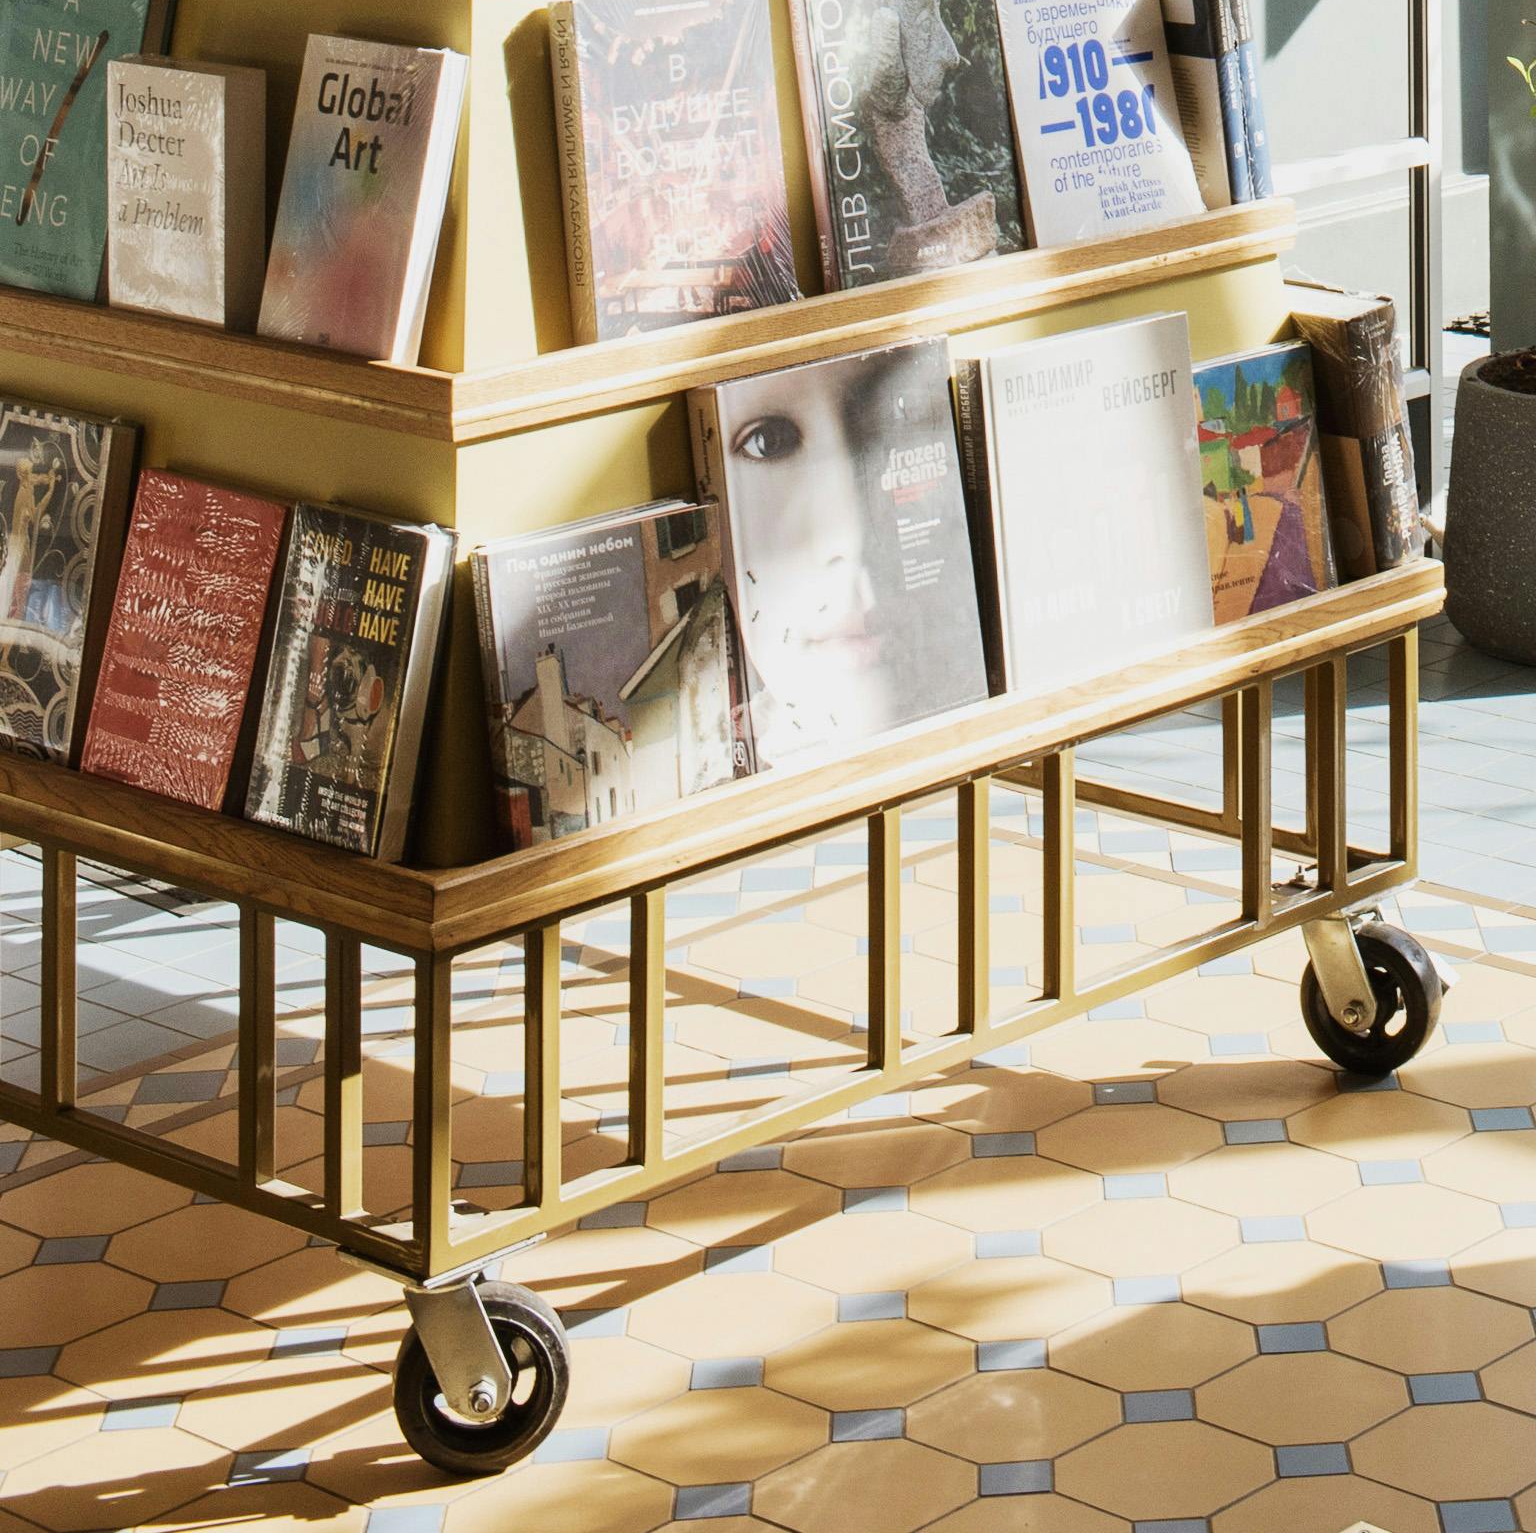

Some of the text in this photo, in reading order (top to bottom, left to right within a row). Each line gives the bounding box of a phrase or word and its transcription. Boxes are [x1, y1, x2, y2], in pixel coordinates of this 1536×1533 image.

[32, 27, 100, 69] NEW
[1027, 19, 1098, 47] будущего
[669, 53, 687, 82] В
[0, 74, 56, 117] WAY
[116, 84, 184, 120] Joshua
[317, 72, 415, 127] Global
[612, 87, 752, 135] БУДУЩЕЕ
[19, 134, 60, 170] OF
[117, 120, 186, 157] Decter
[328, 126, 383, 174] Art
[554, 18, 586, 287] ИЛЬЯ И ЭМИЛИЯ КАБАКОВЫ
[1050, 139, 1163, 171] contemporaries
[116, 159, 169, 188] Art Is
[1054, 174, 1068, 193] of
[1071, 169, 1096, 189] the
[1098, 182, 1129, 198] Jewish
[1103, 199, 1163, 221] Avant-Garde
[1111, 193, 1127, 206] the
[1128, 187, 1166, 204] Russian
[117, 196, 204, 236] a Problem
[842, 192, 876, 274] ЛЕВ
[1004, 358, 1094, 405] ВЛАДИМИР
[1102, 369, 1178, 412] ВЕЙСБЕРГ
[959, 382, 973, 430] ВЕЙСБЕРГ
[889, 441, 947, 470] frozen
[1381, 442, 1391, 486] Глаза
[880, 458, 948, 492] dreams
[368, 546, 412, 582] HAVE
[506, 535, 635, 575] Под одним небом
[534, 559, 592, 581] Французская
[363, 578, 405, 614] HAVE
[536, 579, 611, 604] второй половины
[542, 576, 577, 595] русская
[578, 567, 623, 585] живопись
[552, 608, 592, 625] собрания
[571, 594, 597, 609] веков
[358, 611, 399, 646] HAVE
[538, 612, 615, 639] Инны Баженовой
